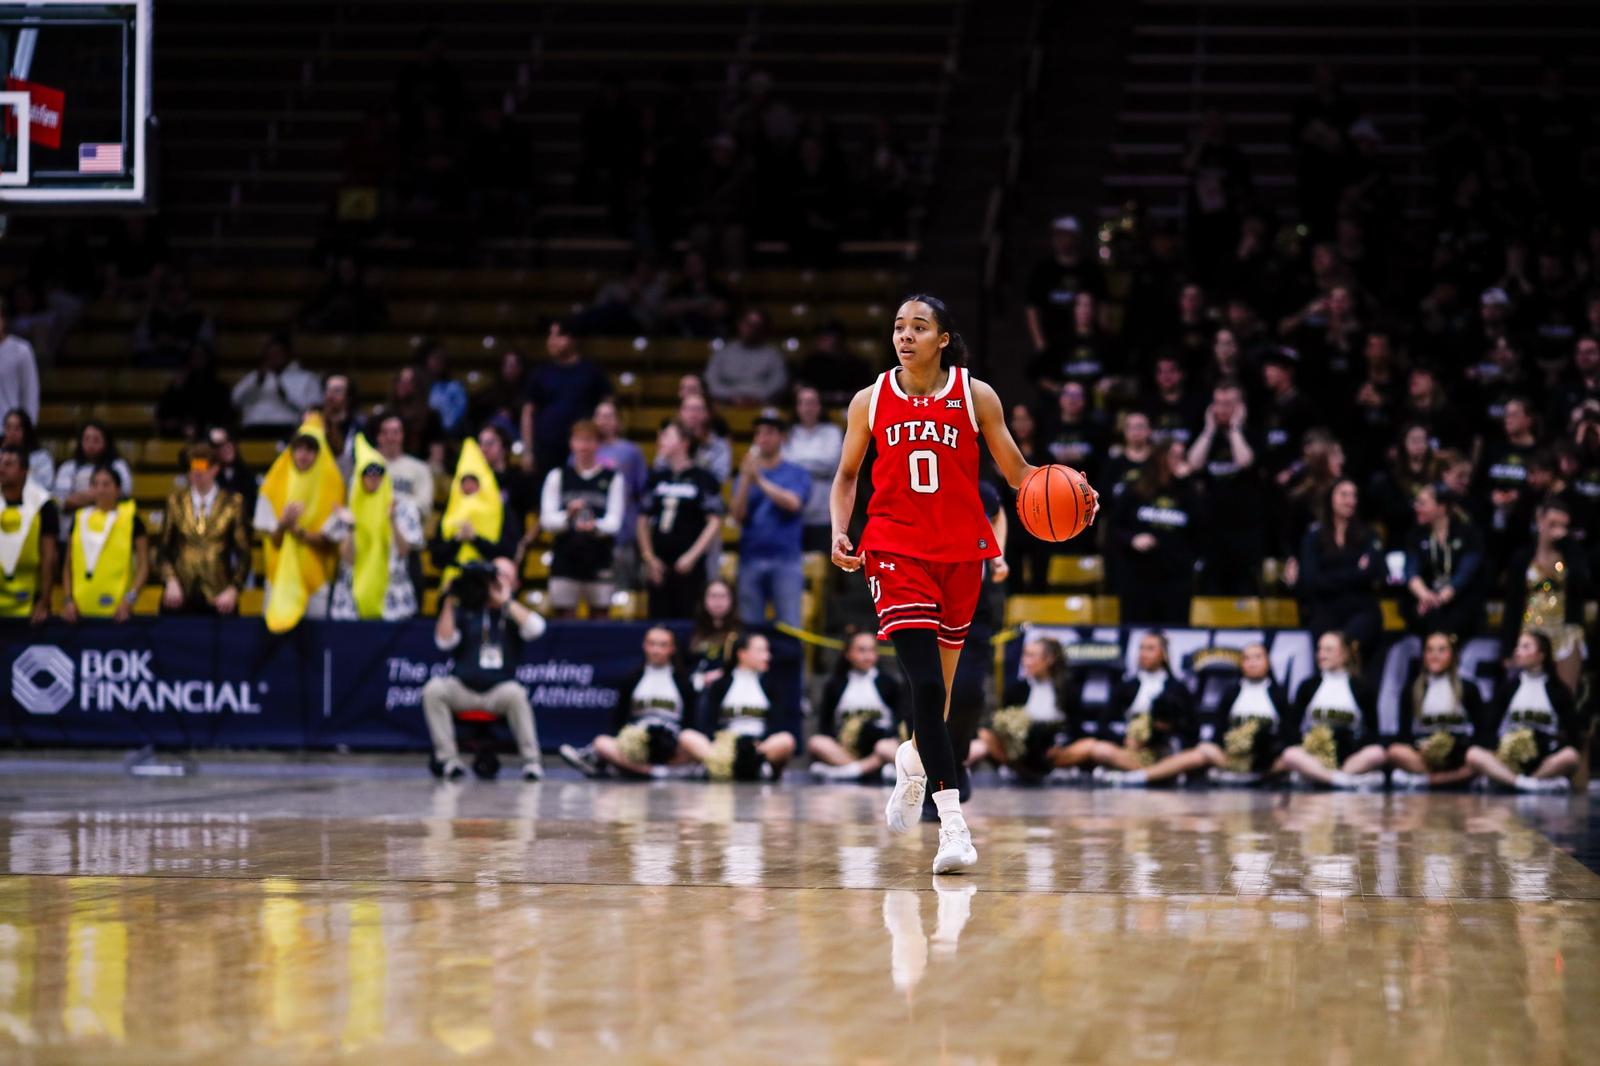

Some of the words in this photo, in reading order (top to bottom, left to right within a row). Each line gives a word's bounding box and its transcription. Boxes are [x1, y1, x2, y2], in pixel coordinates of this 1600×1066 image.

[885, 420, 959, 449] UTAH
[908, 449, 940, 494] 0
[81, 649, 154, 681] BOK
[386, 657, 428, 682] The
[80, 680, 262, 713] FINANCIAL
